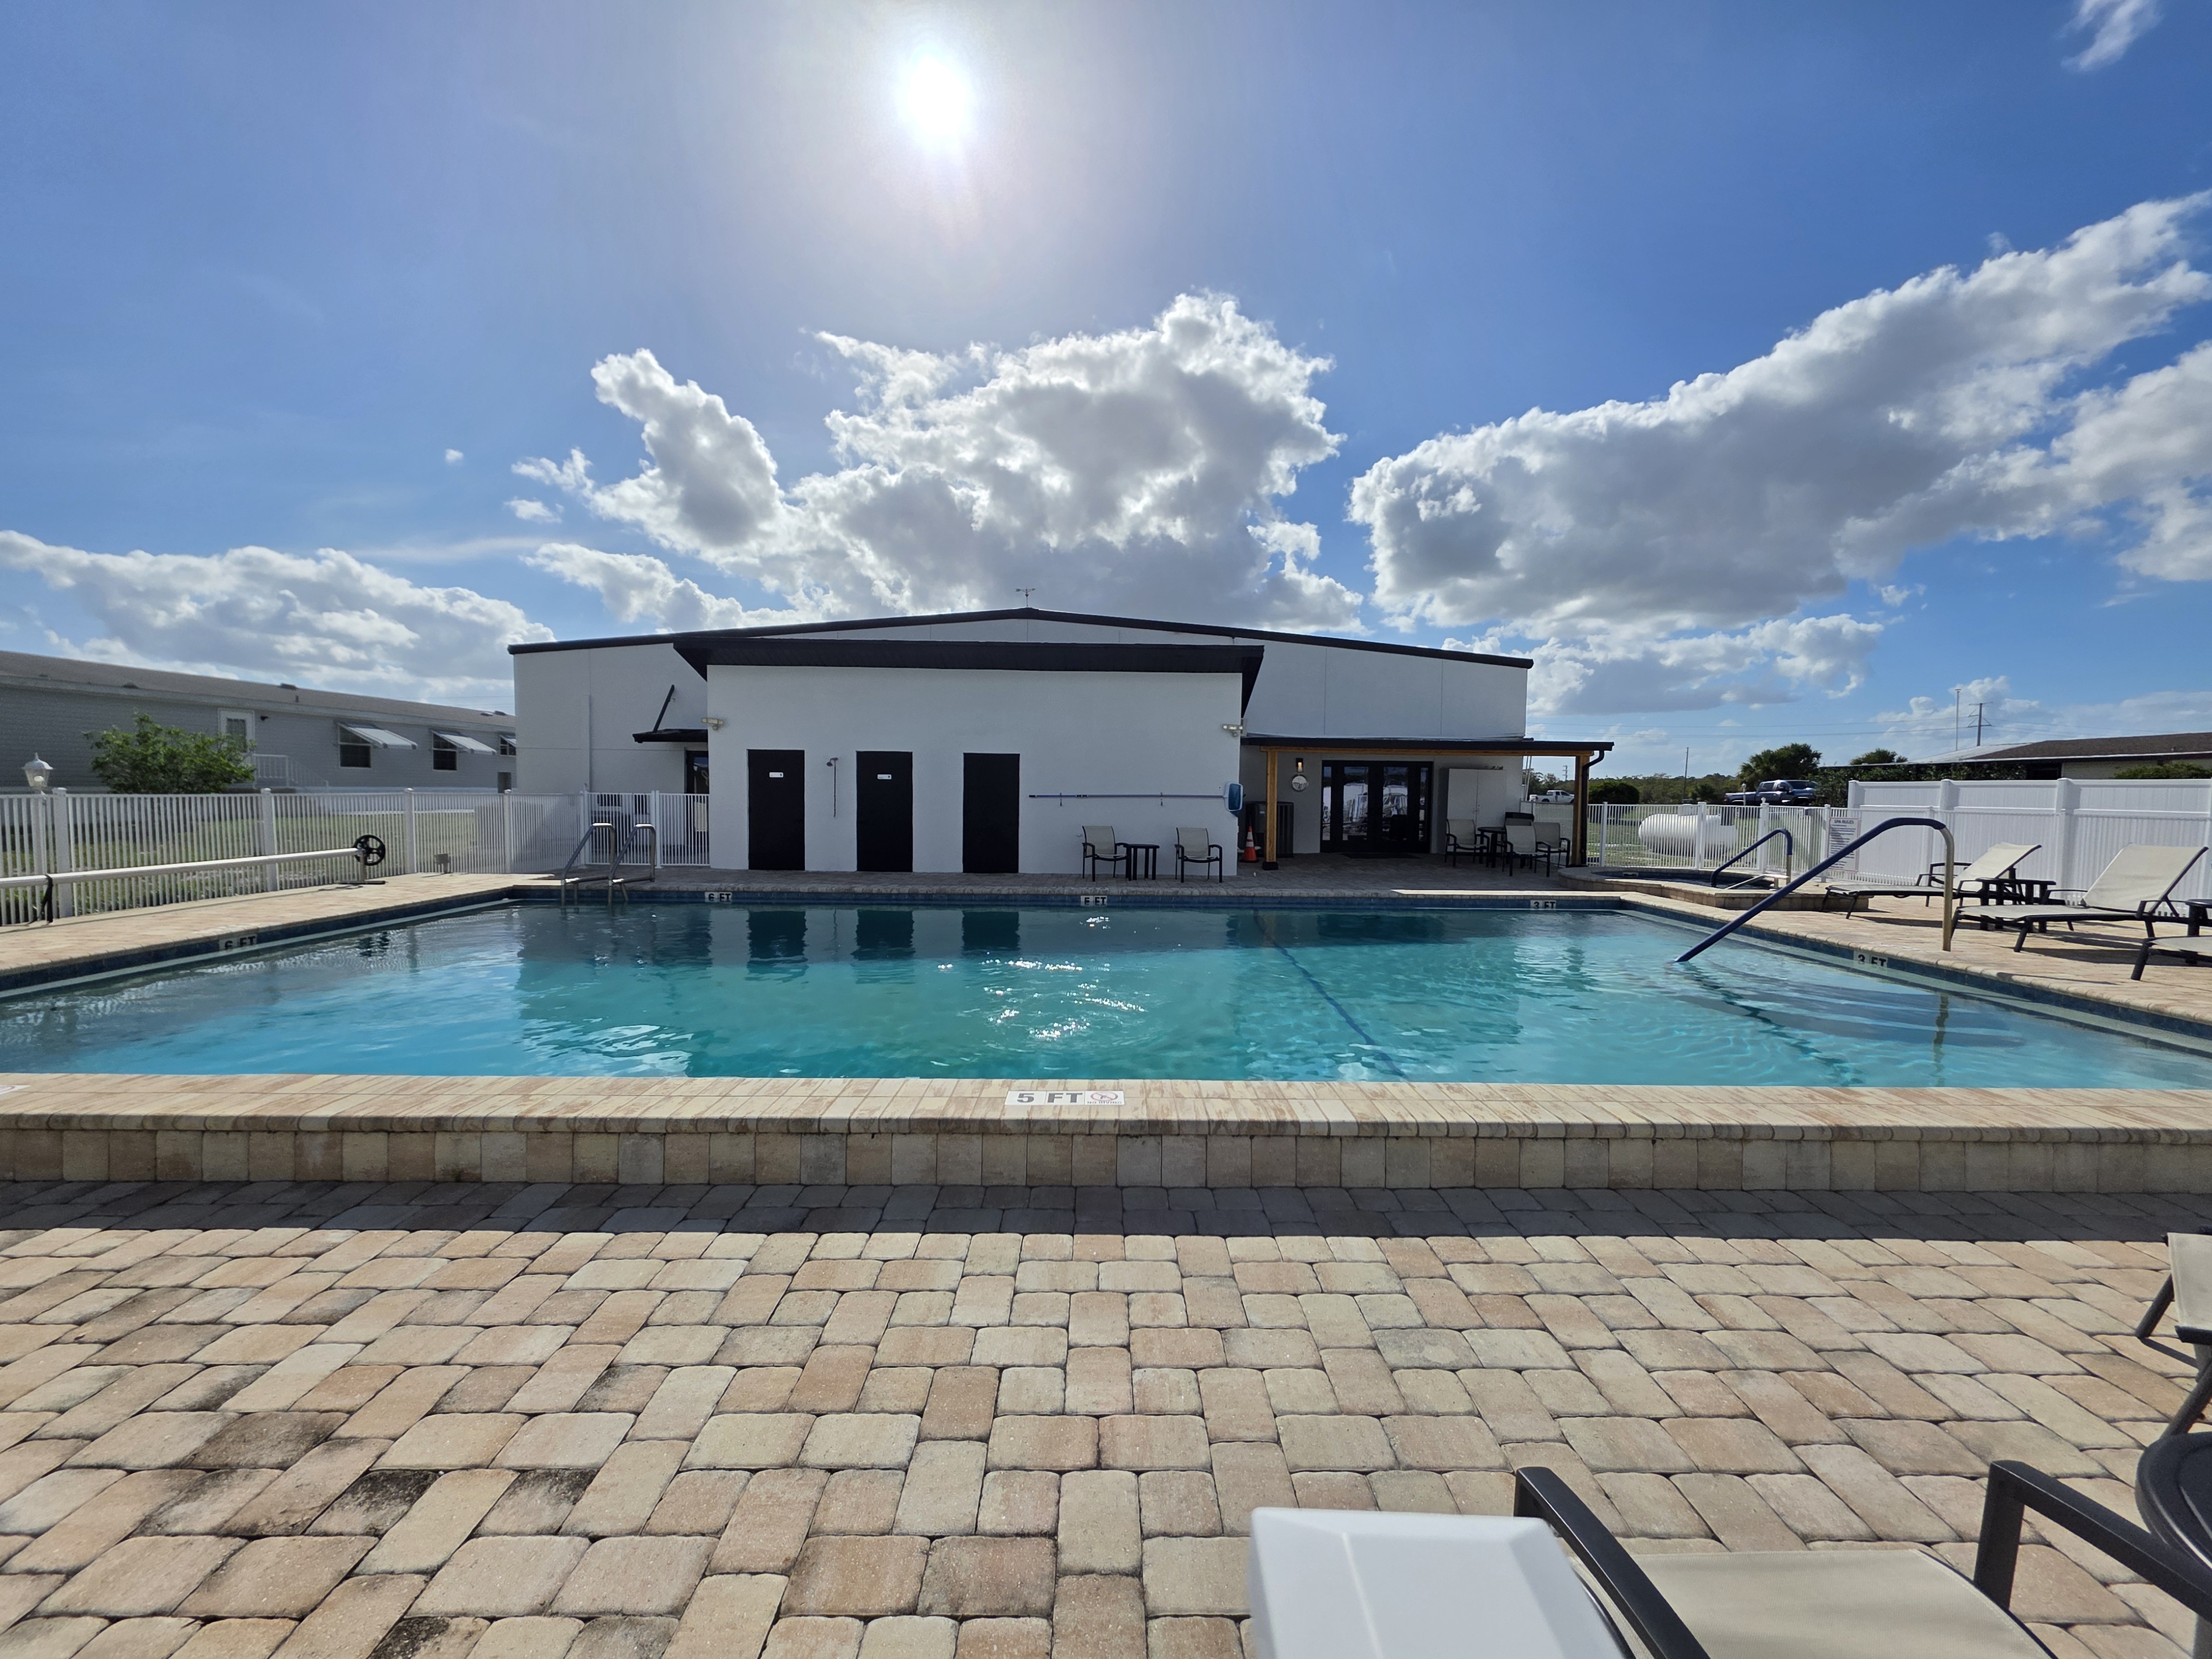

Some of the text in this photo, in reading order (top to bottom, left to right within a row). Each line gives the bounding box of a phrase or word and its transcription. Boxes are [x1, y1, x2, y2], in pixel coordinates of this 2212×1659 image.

[719, 893, 731, 902] FT
[239, 936, 255, 947] FT
[1858, 954, 1886, 967] 3 FT
[1017, 1093, 1083, 1103] 5 FT
